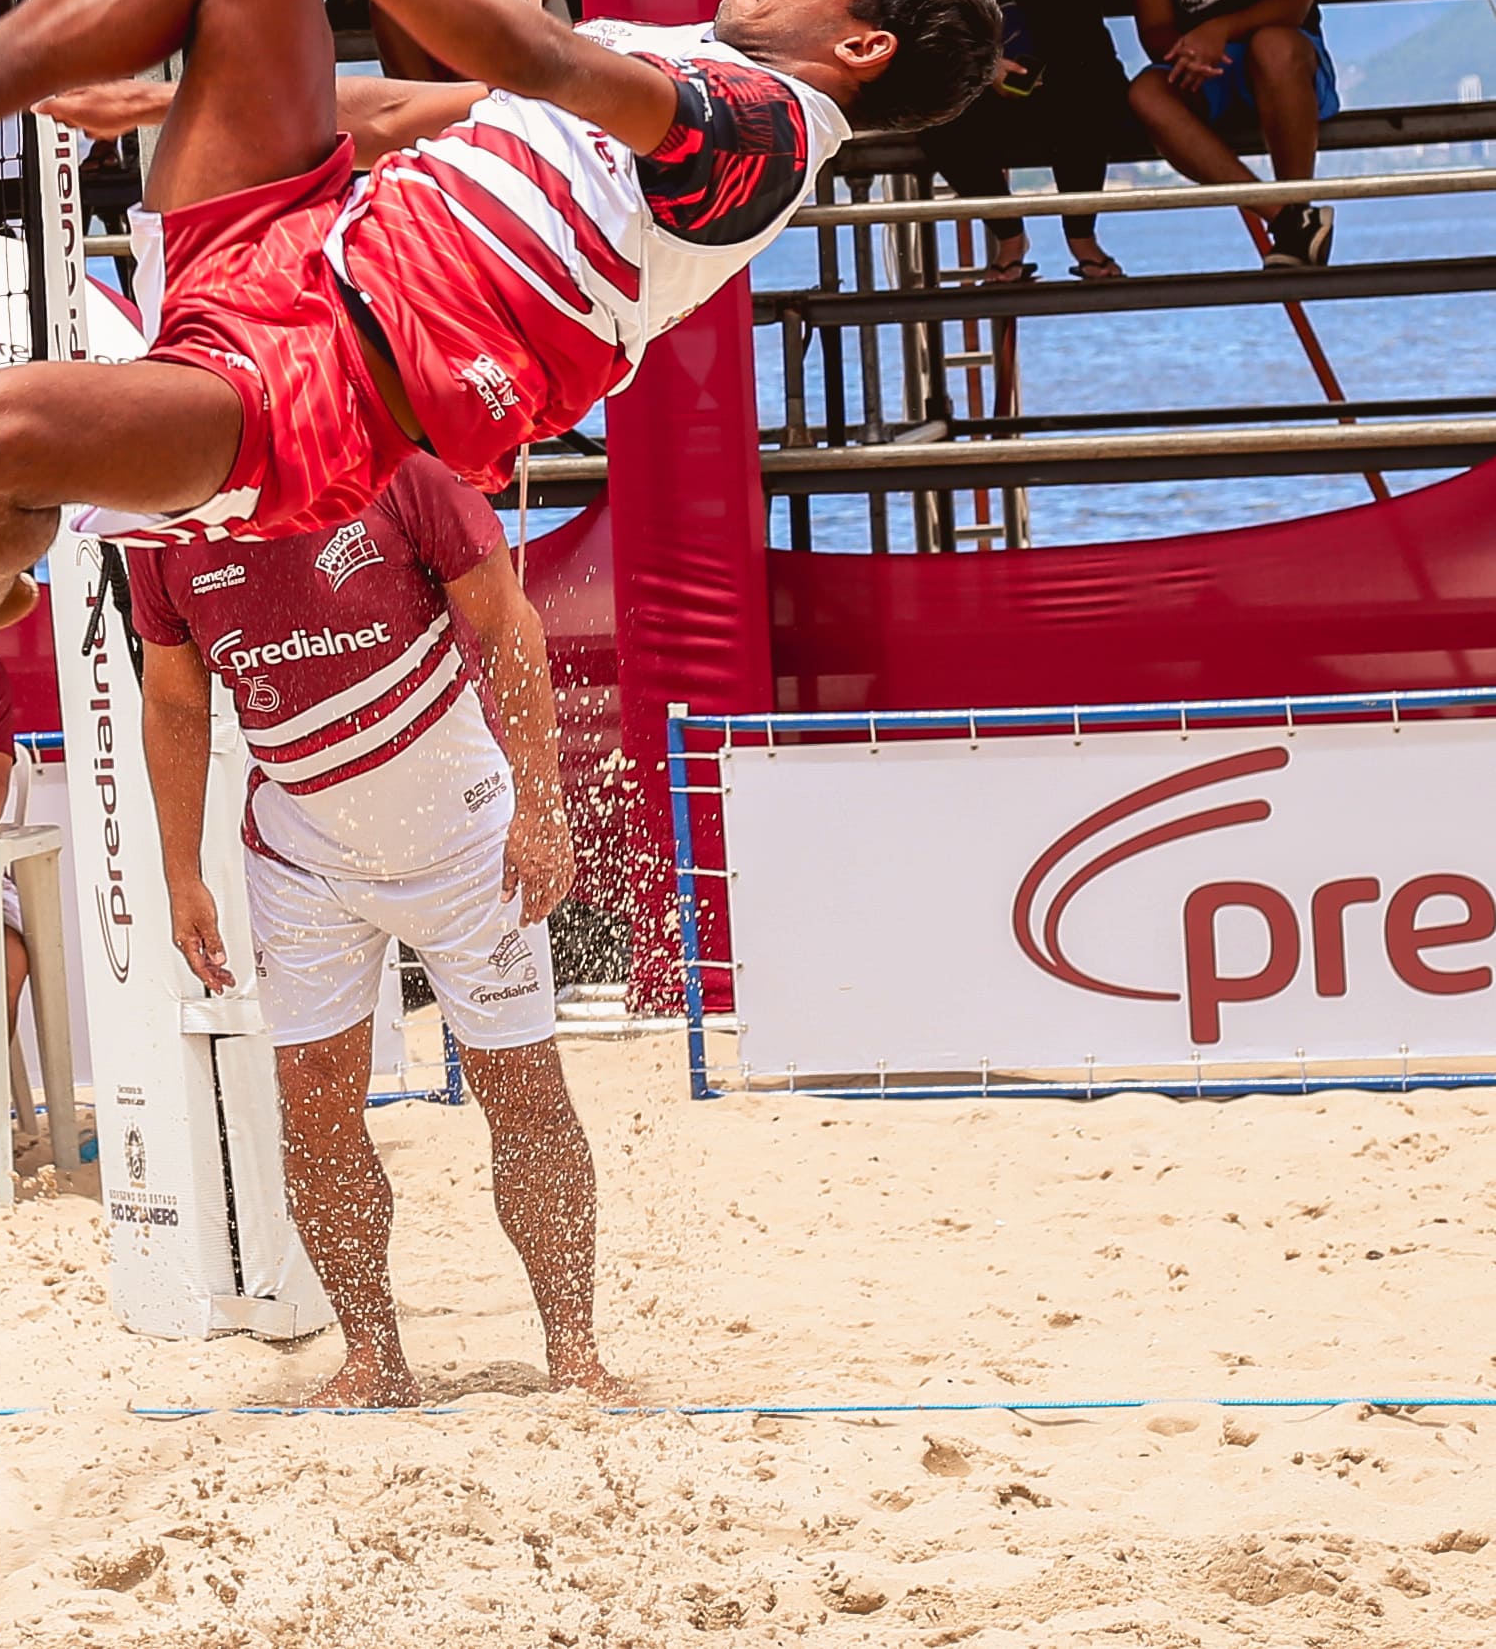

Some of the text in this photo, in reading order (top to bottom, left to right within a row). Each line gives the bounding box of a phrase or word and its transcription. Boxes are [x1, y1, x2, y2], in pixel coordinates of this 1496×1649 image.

[461, 368, 506, 421] SPORTS
[192, 562, 246, 588] conexão
[229, 621, 392, 677] predialnet
[85, 580, 133, 926] predialnet
[478, 980, 540, 1006] predialnet
